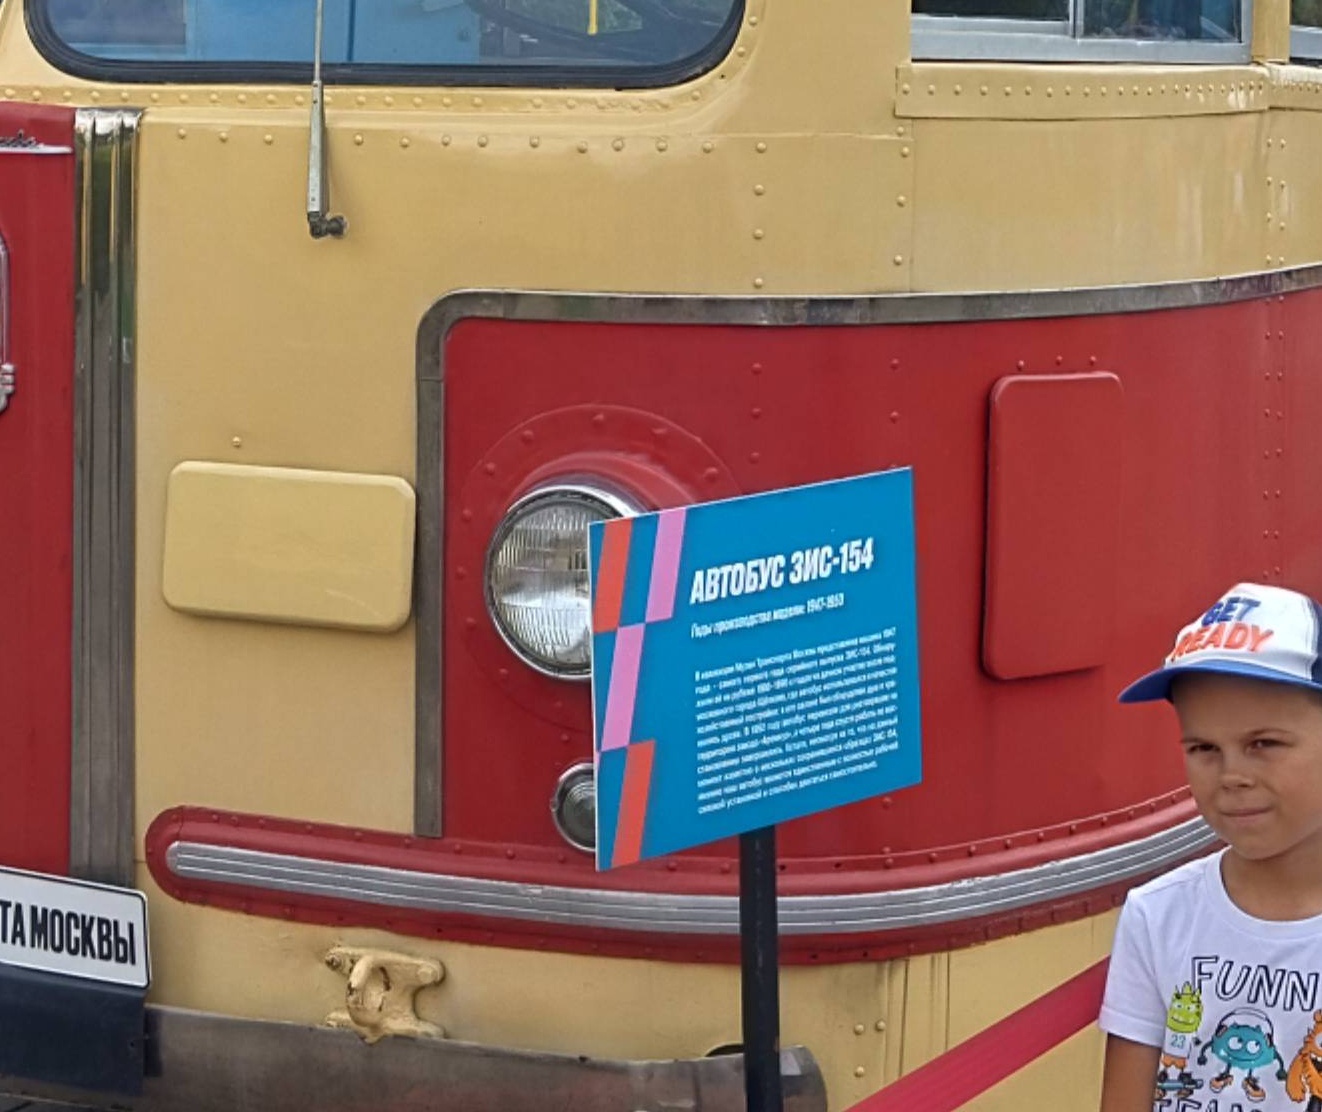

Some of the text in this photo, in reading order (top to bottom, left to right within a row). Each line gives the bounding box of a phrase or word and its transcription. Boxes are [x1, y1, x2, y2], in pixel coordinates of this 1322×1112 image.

[689, 537, 875, 605] АВТОБУС ЗИС-154
[1201, 596, 1262, 627] GET
[1170, 621, 1275, 662] READY
[29, 905, 137, 967] МОСКВЫ
[1170, 1034, 1186, 1049] 23
